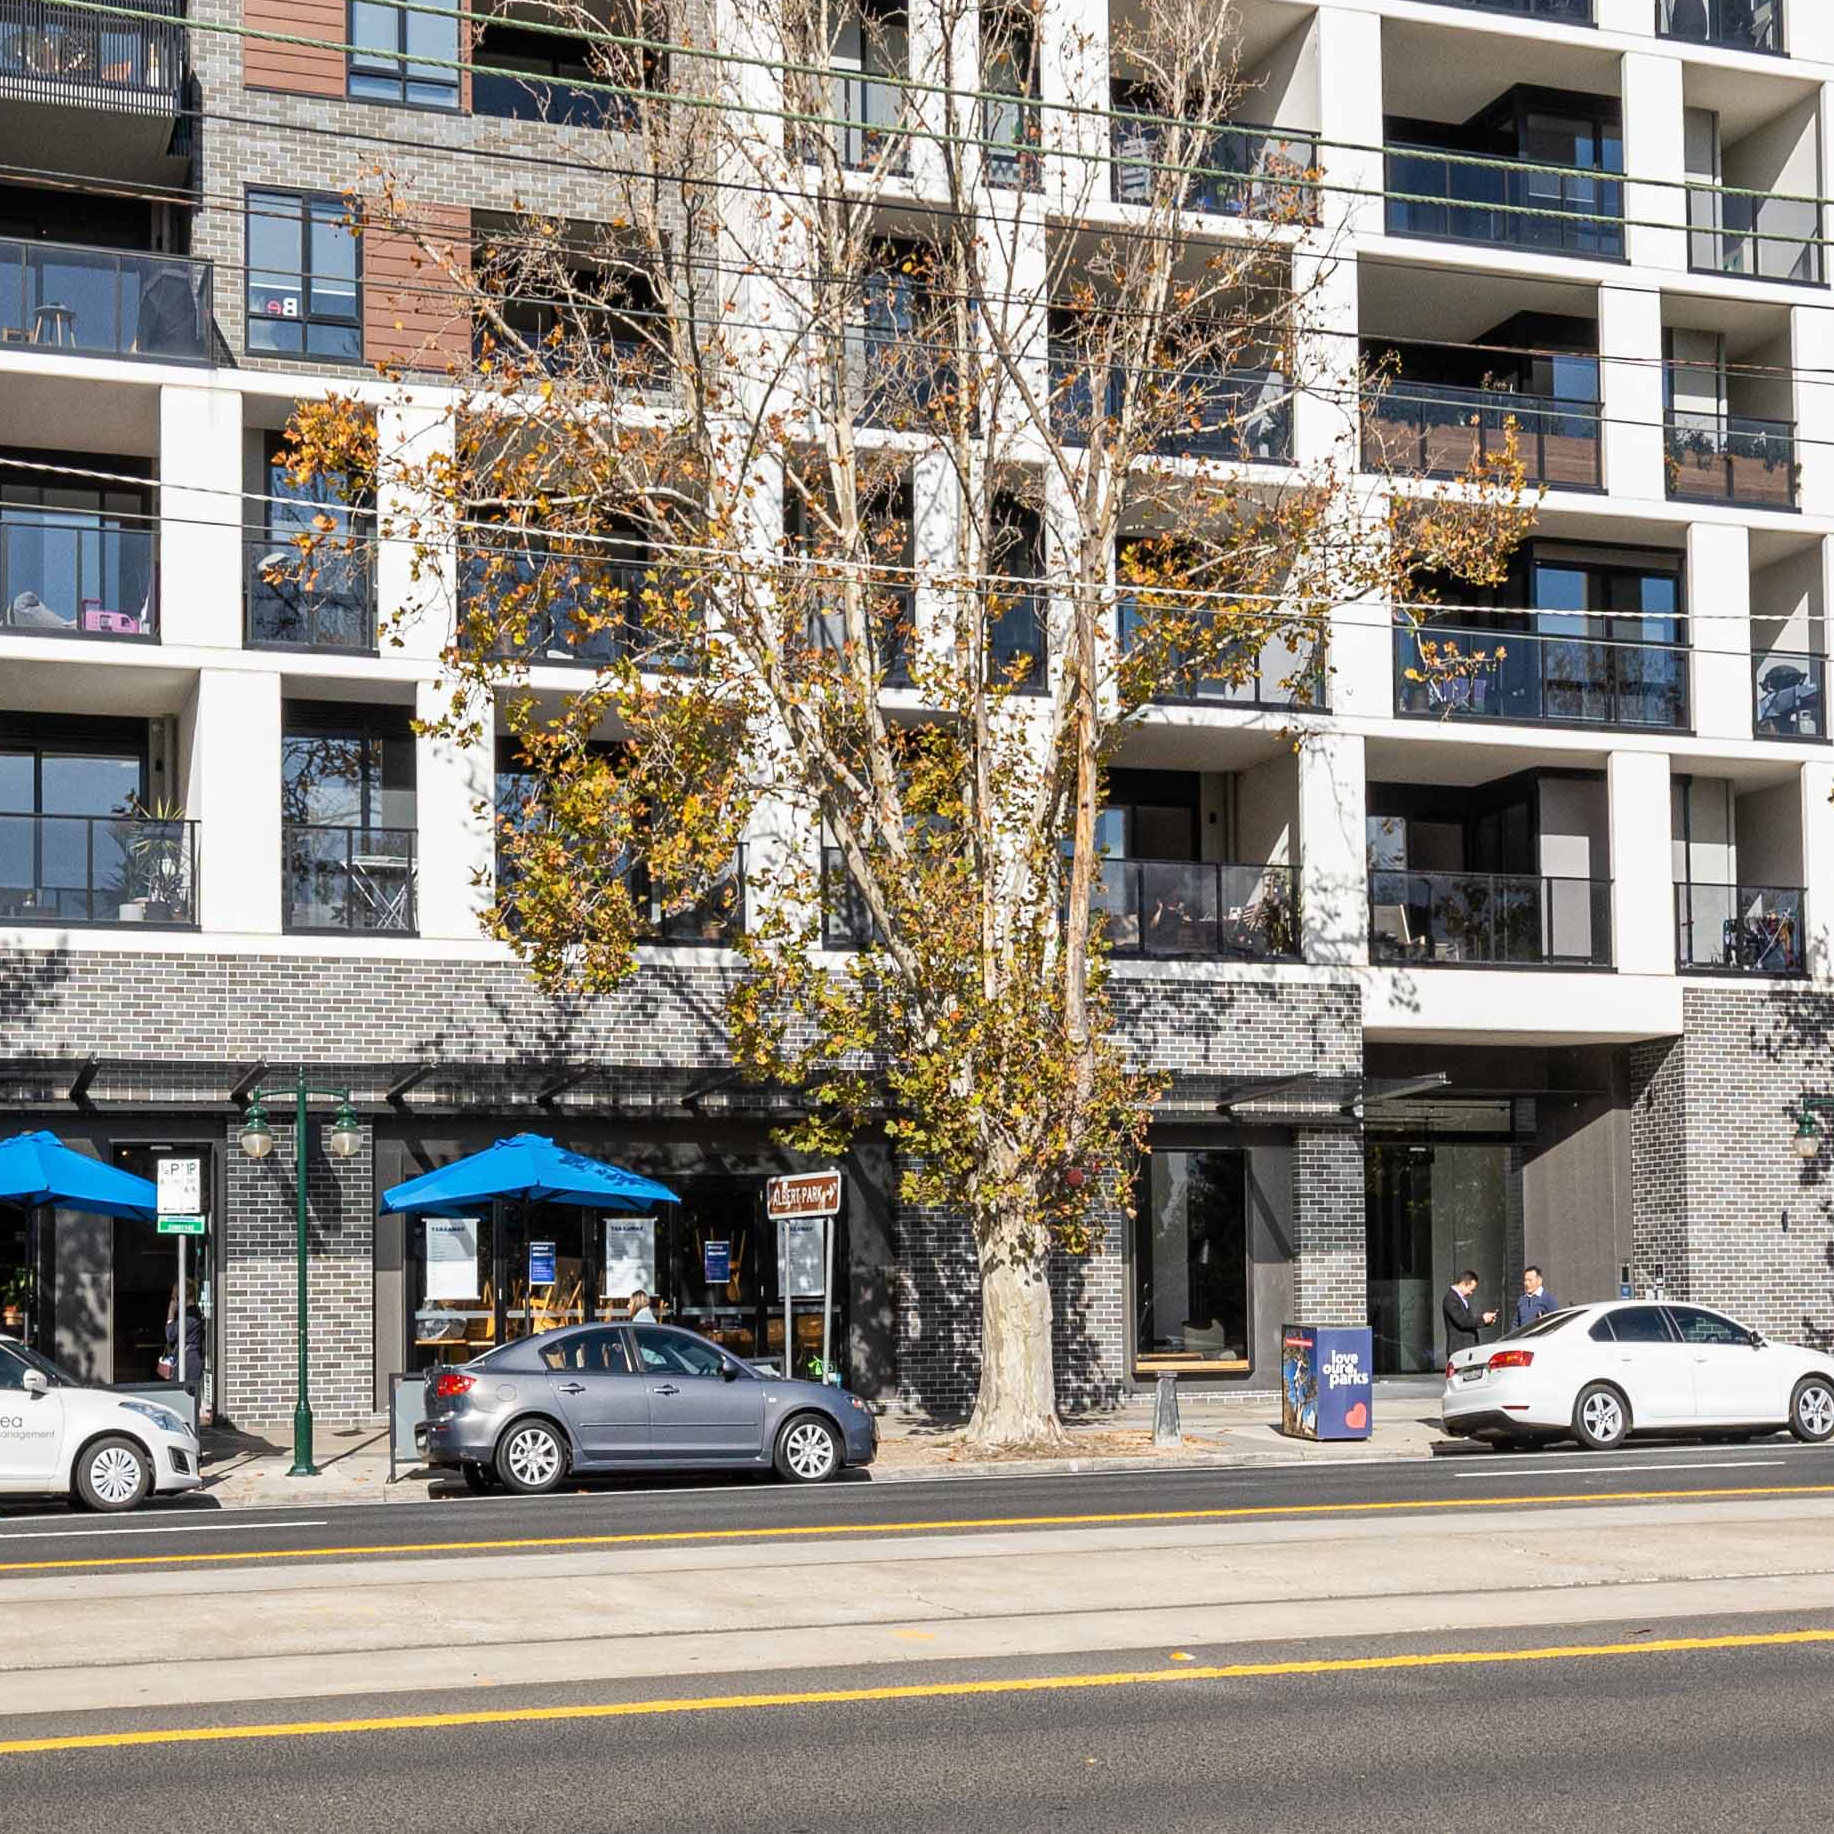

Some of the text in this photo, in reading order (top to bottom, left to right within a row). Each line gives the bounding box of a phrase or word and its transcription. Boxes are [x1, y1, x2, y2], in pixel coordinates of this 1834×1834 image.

[772, 1185, 824, 1207] ALBERT PARK
[1331, 1349, 1359, 1364] love
[1329, 1369, 1369, 1390] parks
